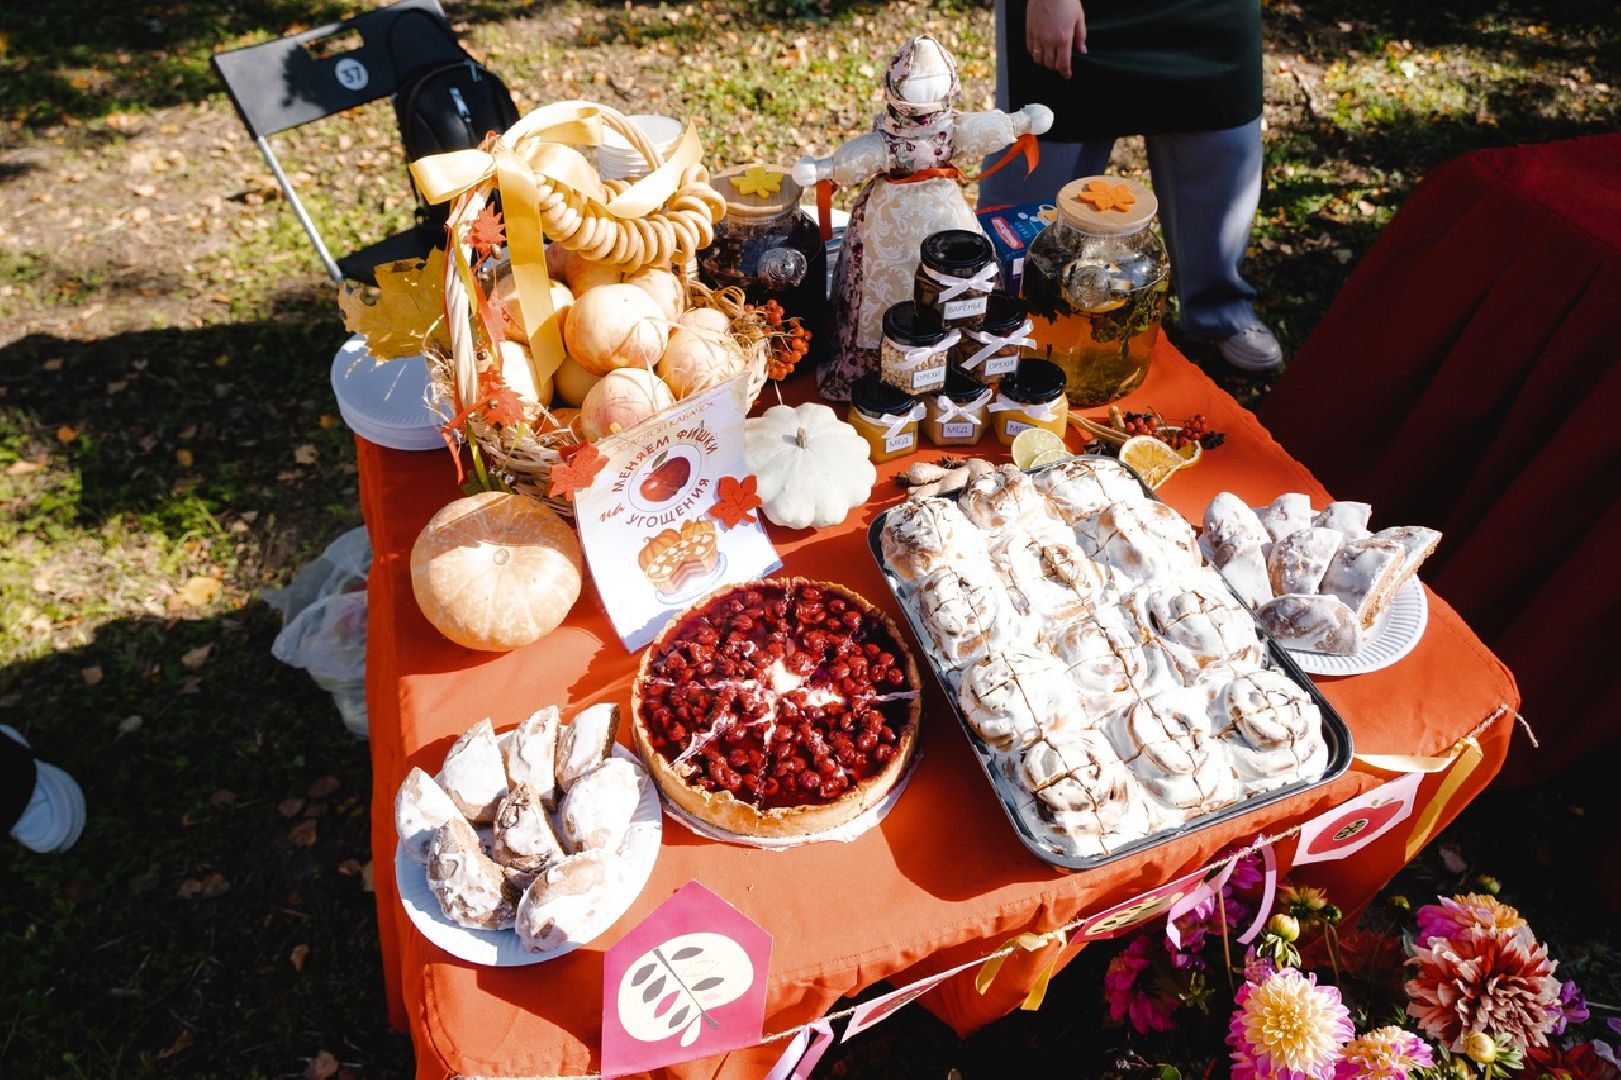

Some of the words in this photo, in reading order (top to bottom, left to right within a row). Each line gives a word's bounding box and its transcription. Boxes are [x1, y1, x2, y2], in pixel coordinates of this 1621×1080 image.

[612, 435, 669, 492] МЕНЯЕМ
[676, 428, 718, 455] ФИШКИ
[626, 478, 710, 527] УГОЩЕНИЯ
